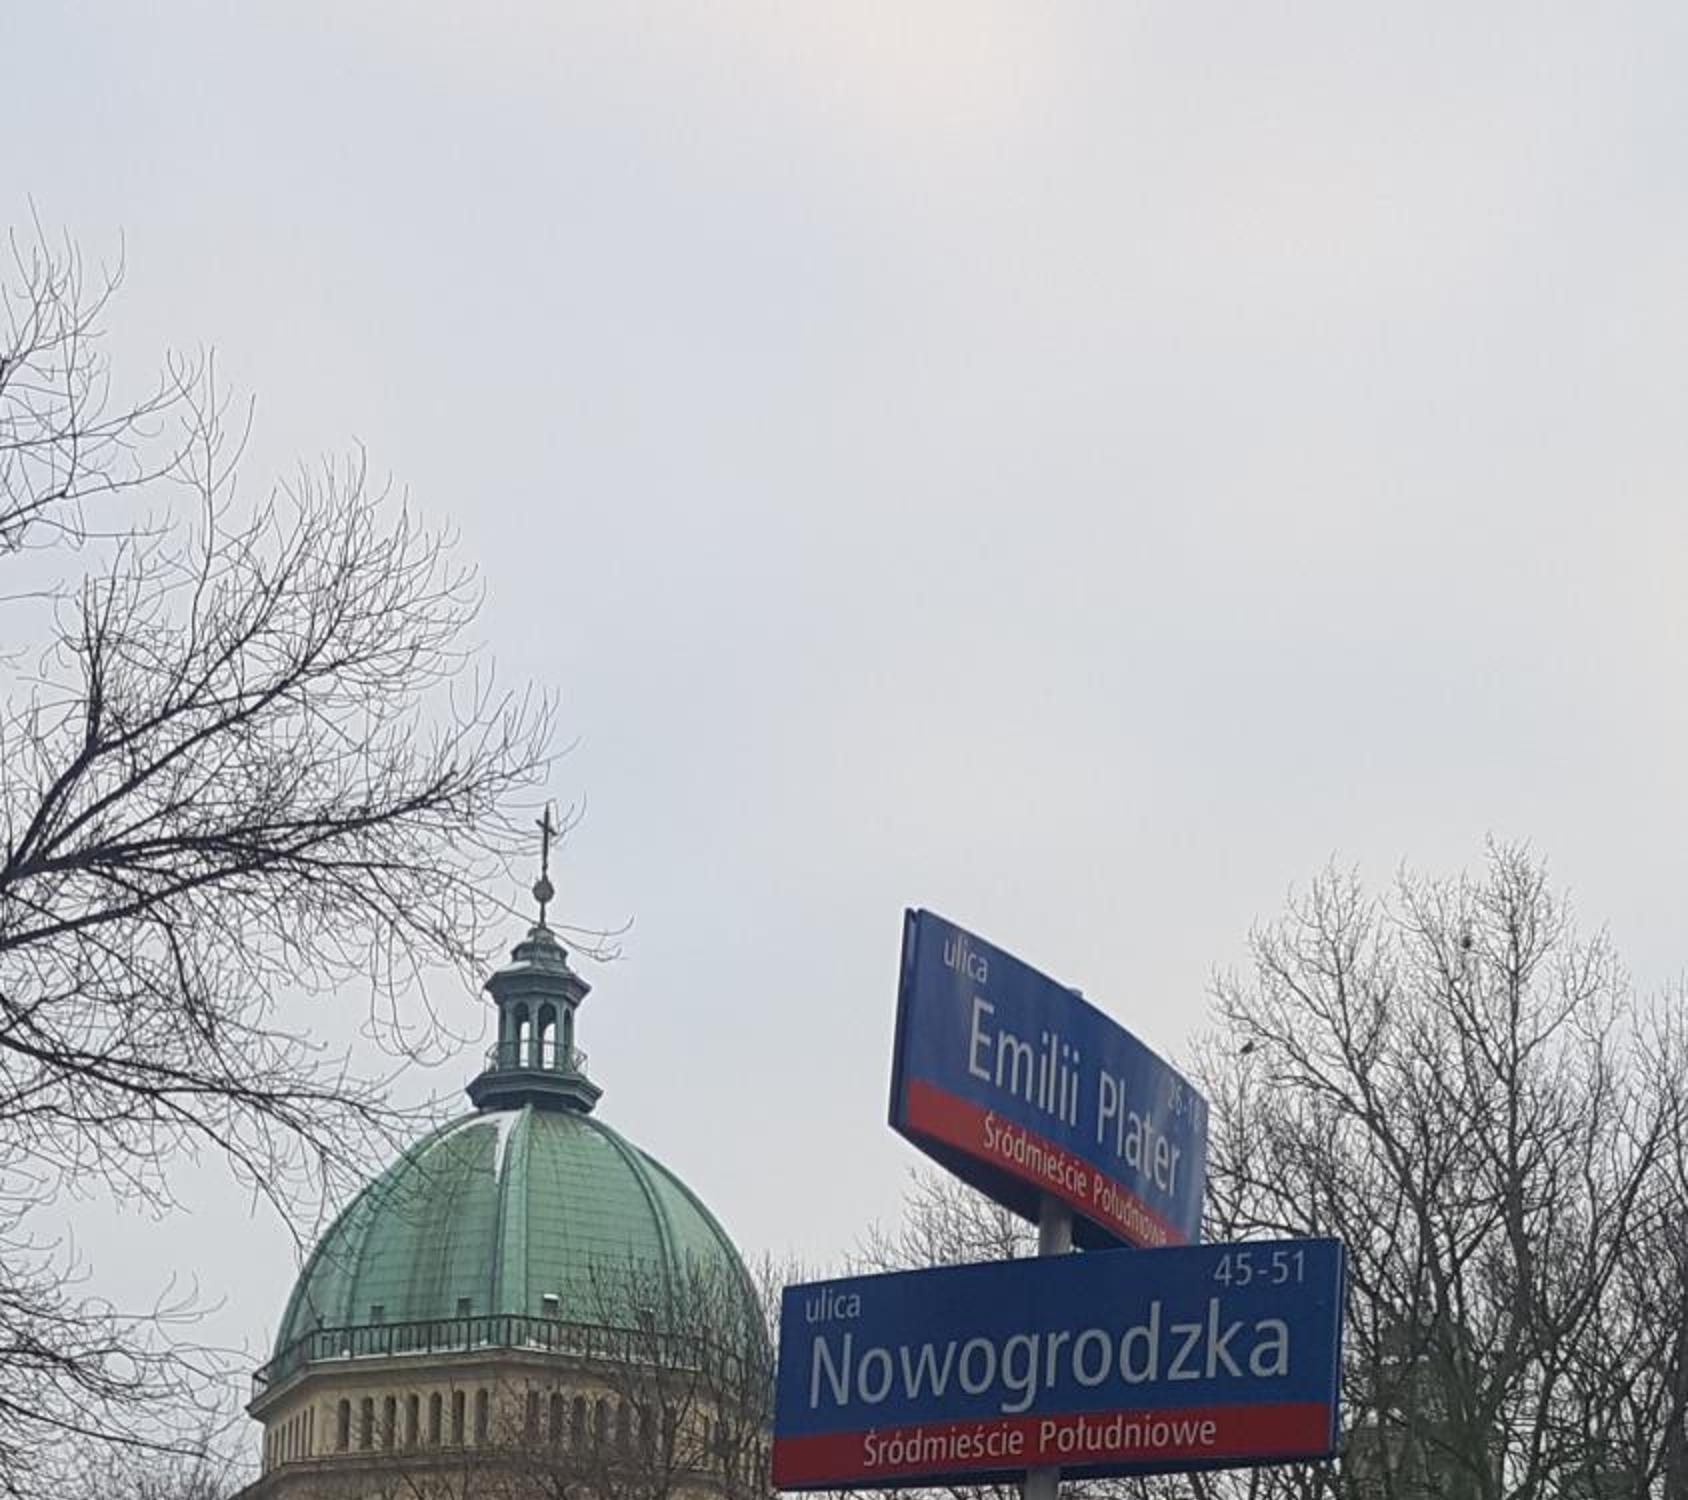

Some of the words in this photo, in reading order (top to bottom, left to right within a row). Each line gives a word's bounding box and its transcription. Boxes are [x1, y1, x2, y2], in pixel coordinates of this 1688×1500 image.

[943, 932, 989, 984] ulica
[968, 996, 1080, 1127] Emilii
[1097, 1070, 1181, 1196] Plater
[983, 1111, 1088, 1197] Śródmieście
[1213, 1249, 1306, 1287] 45-51
[805, 1288, 862, 1323] ulica
[808, 1297, 1290, 1413] Nowogrodzka
[862, 1428, 1025, 1467] Śródmieście
[1039, 1415, 1218, 1454] Południowe
